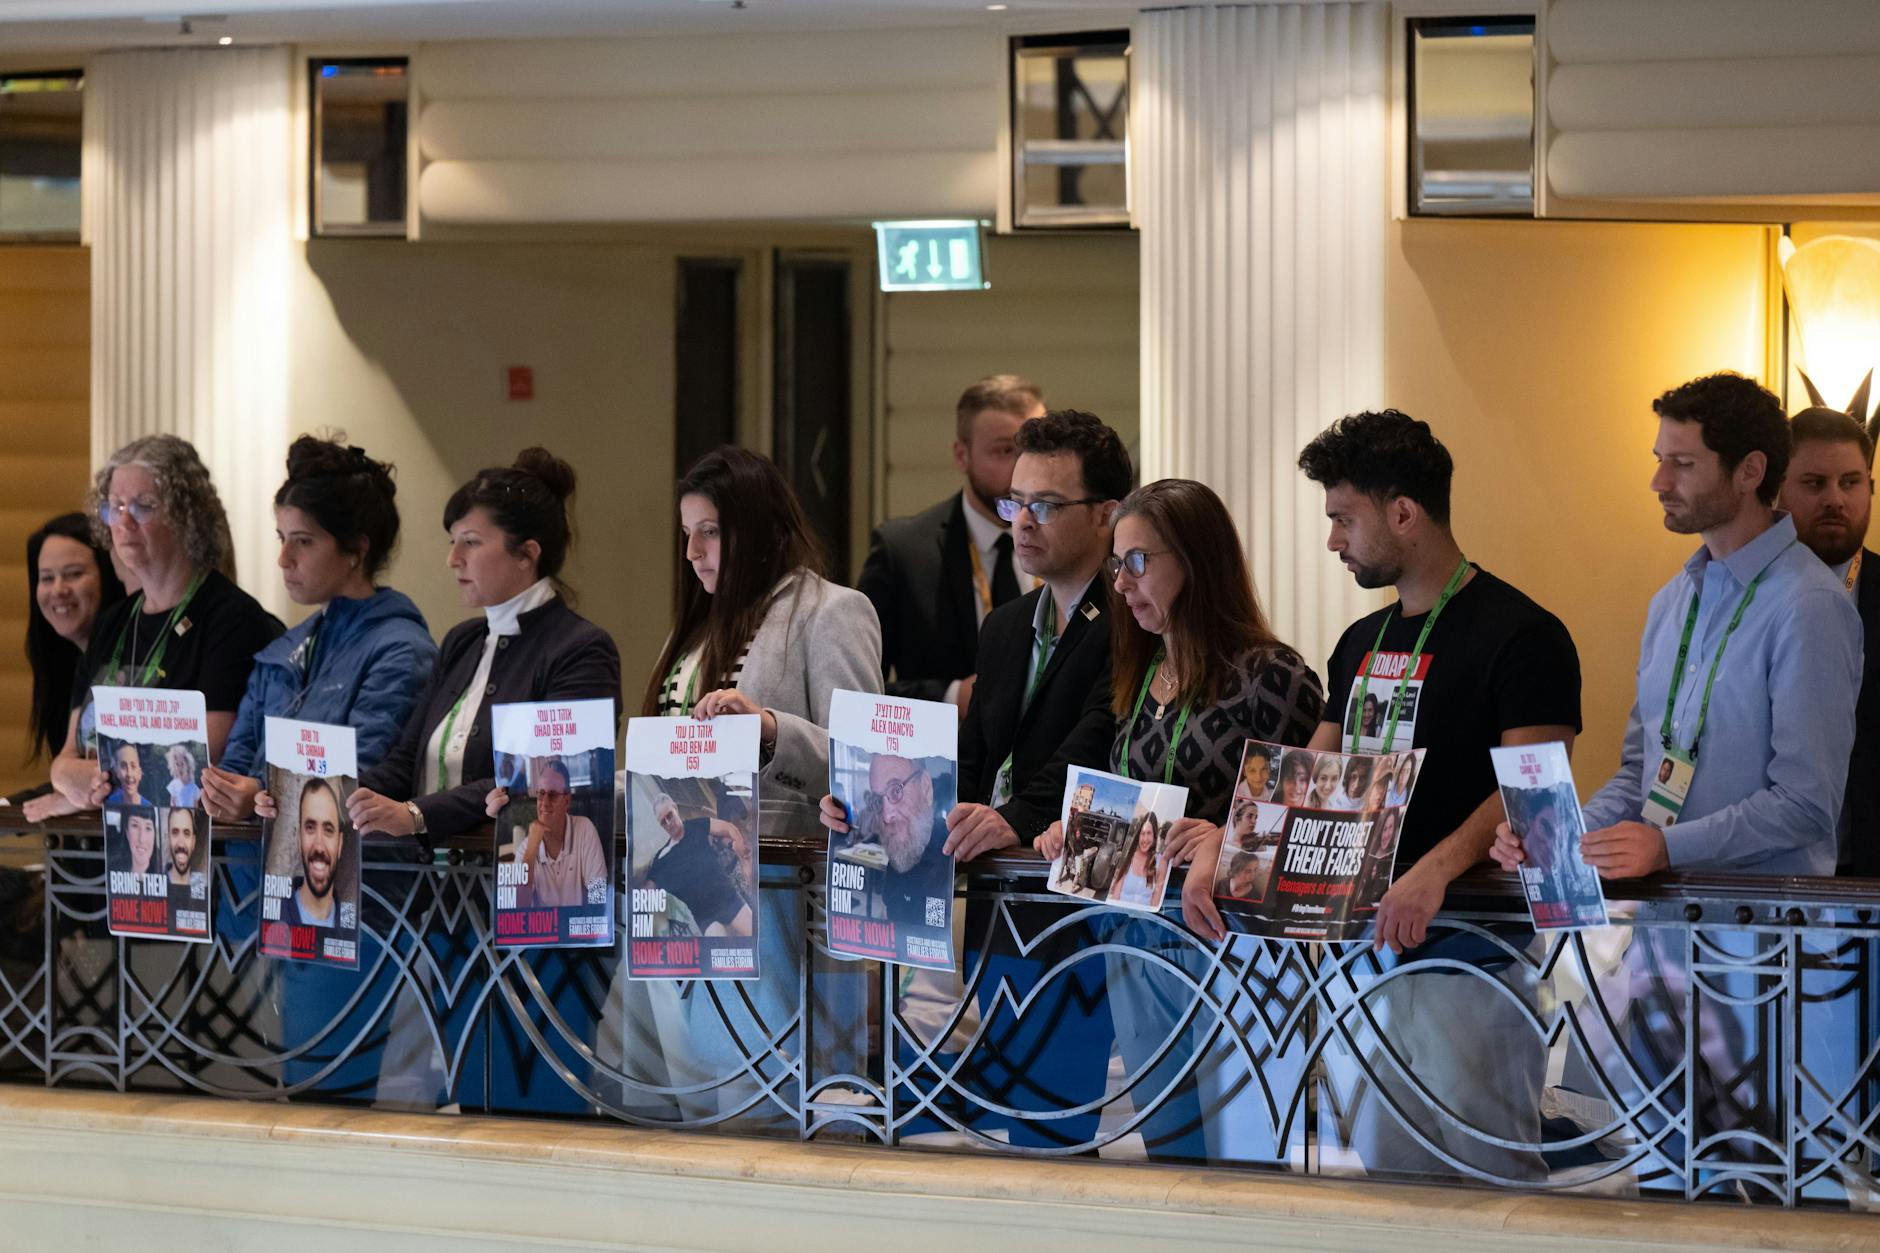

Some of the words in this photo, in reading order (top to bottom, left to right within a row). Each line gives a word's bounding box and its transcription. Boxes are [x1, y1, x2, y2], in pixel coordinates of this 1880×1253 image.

[150, 716, 161, 729] AND
[174, 717, 198, 731] SHOHAM
[534, 725, 551, 737] OHAD
[552, 724, 564, 736] BEN
[565, 723, 576, 735] AMI
[688, 726, 695, 740] בן
[871, 719, 887, 734] ALEX
[888, 721, 914, 737] DANCYG
[550, 738, 562, 752] (55)
[670, 741, 687, 754] OHAD
[689, 741, 701, 754] BEN
[704, 740, 717, 753] AMI
[886, 735, 899, 752] (75)
[686, 756, 700, 771] (55)
[1289, 816, 1332, 845] DON'T
[1330, 821, 1374, 848] FORGET
[1283, 844, 1327, 874] THEIR
[1325, 848, 1366, 876] FACES
[110, 870, 140, 895] BRING
[142, 873, 168, 897] THEM
[497, 863, 529, 885] BRING
[831, 862, 864, 890] BRING
[264, 874, 292, 899] BRING
[497, 886, 517, 909] HIM
[1277, 876, 1317, 896] Teenagers
[112, 898, 139, 922] HOME
[141, 897, 167, 925] NOW!
[263, 897, 281, 920] HIM
[632, 888, 666, 912] BRING
[831, 887, 852, 914] HIM
[496, 912, 526, 935] HOME
[528, 908, 558, 934] NOW!
[632, 914, 654, 937] HIM
[832, 915, 862, 942] HOME
[864, 921, 895, 949] NOW!
[291, 925, 315, 950] NOW!
[631, 941, 664, 965] HOME
[667, 937, 700, 965] NOW!
[711, 956, 735, 968] FAMILIES
[735, 956, 753, 968] FORUM
[907, 943, 929, 957] FAMILIES
[929, 947, 949, 960] FORUM
